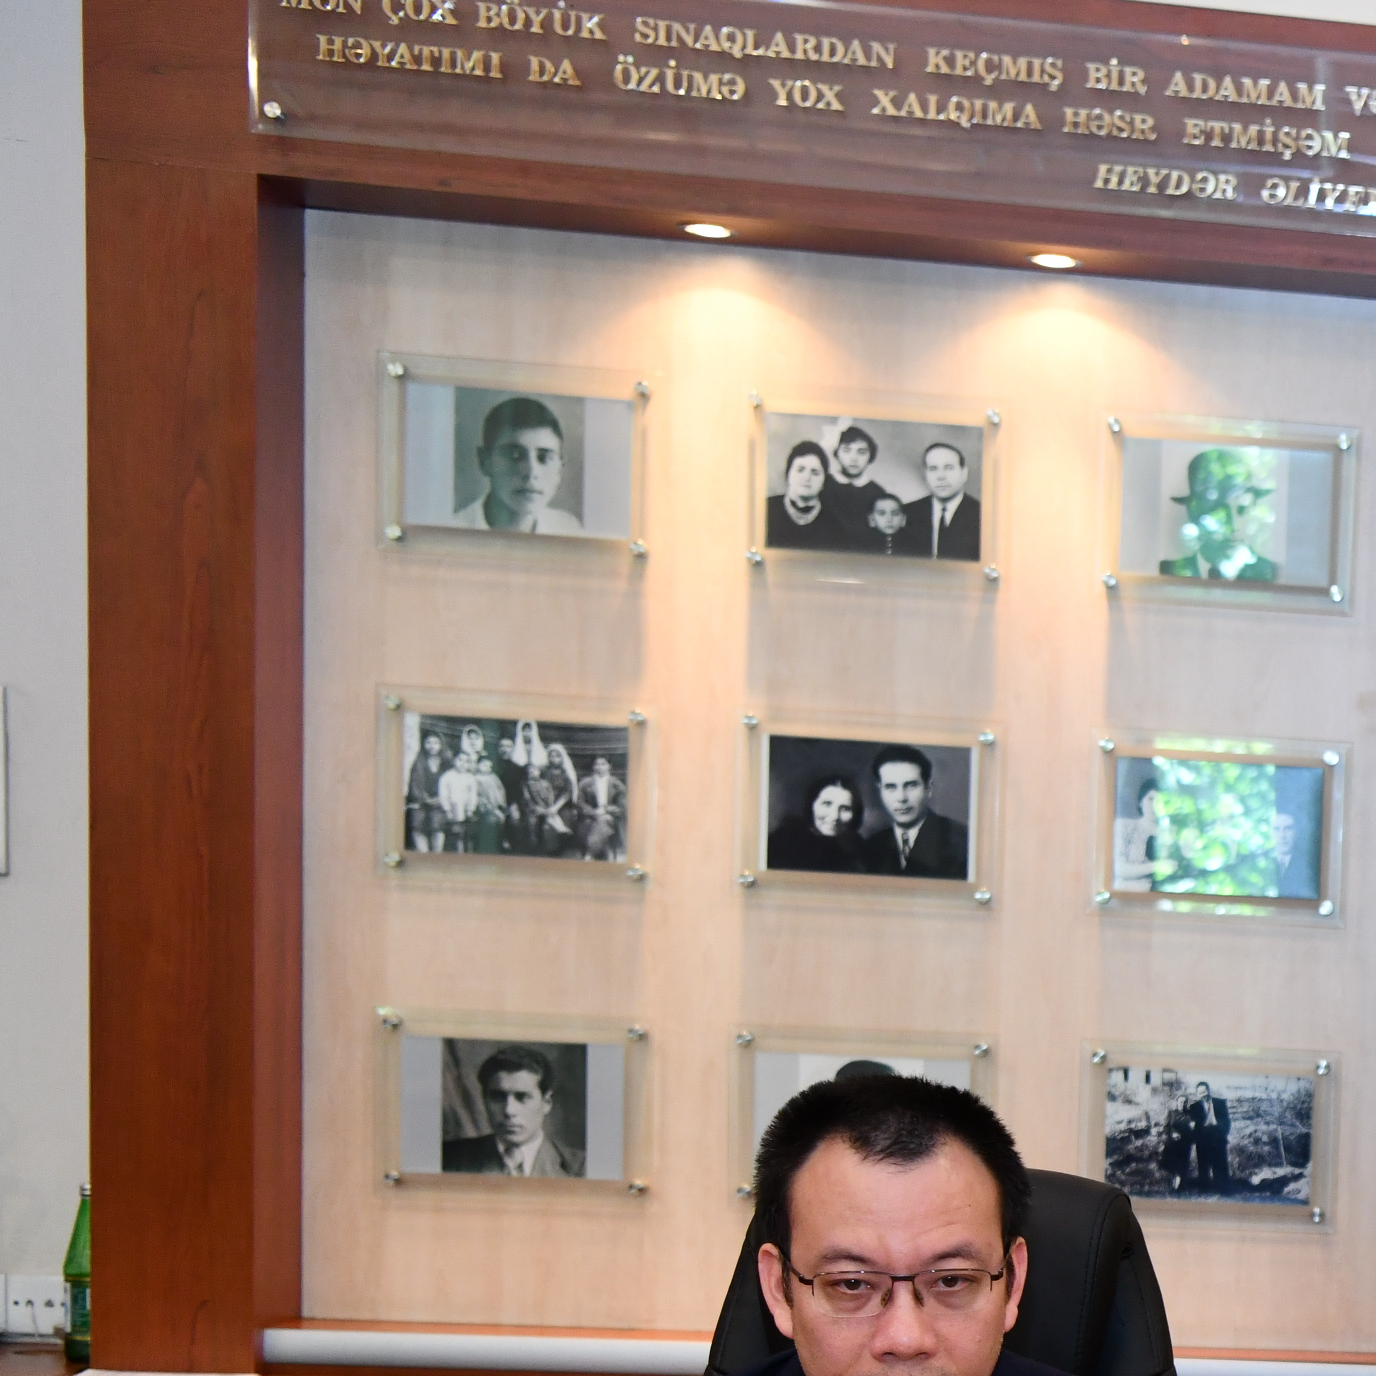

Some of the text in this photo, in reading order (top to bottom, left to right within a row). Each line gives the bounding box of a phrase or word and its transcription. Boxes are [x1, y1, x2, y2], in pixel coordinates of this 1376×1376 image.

[316, 34, 503, 79] HƏYATIMI
[528, 55, 582, 86] DA
[770, 77, 844, 112] YOX
[872, 89, 1042, 131] XALQIMA
[1063, 106, 1157, 142] HƏSR
[1183, 117, 1350, 160] ETMİŞƏM
[634, 16, 895, 69] SINAQLARDAN
[1086, 57, 1146, 95] BİR
[1165, 71, 1326, 111] ADAMAM
[1092, 164, 1238, 201] HEYDƏR
